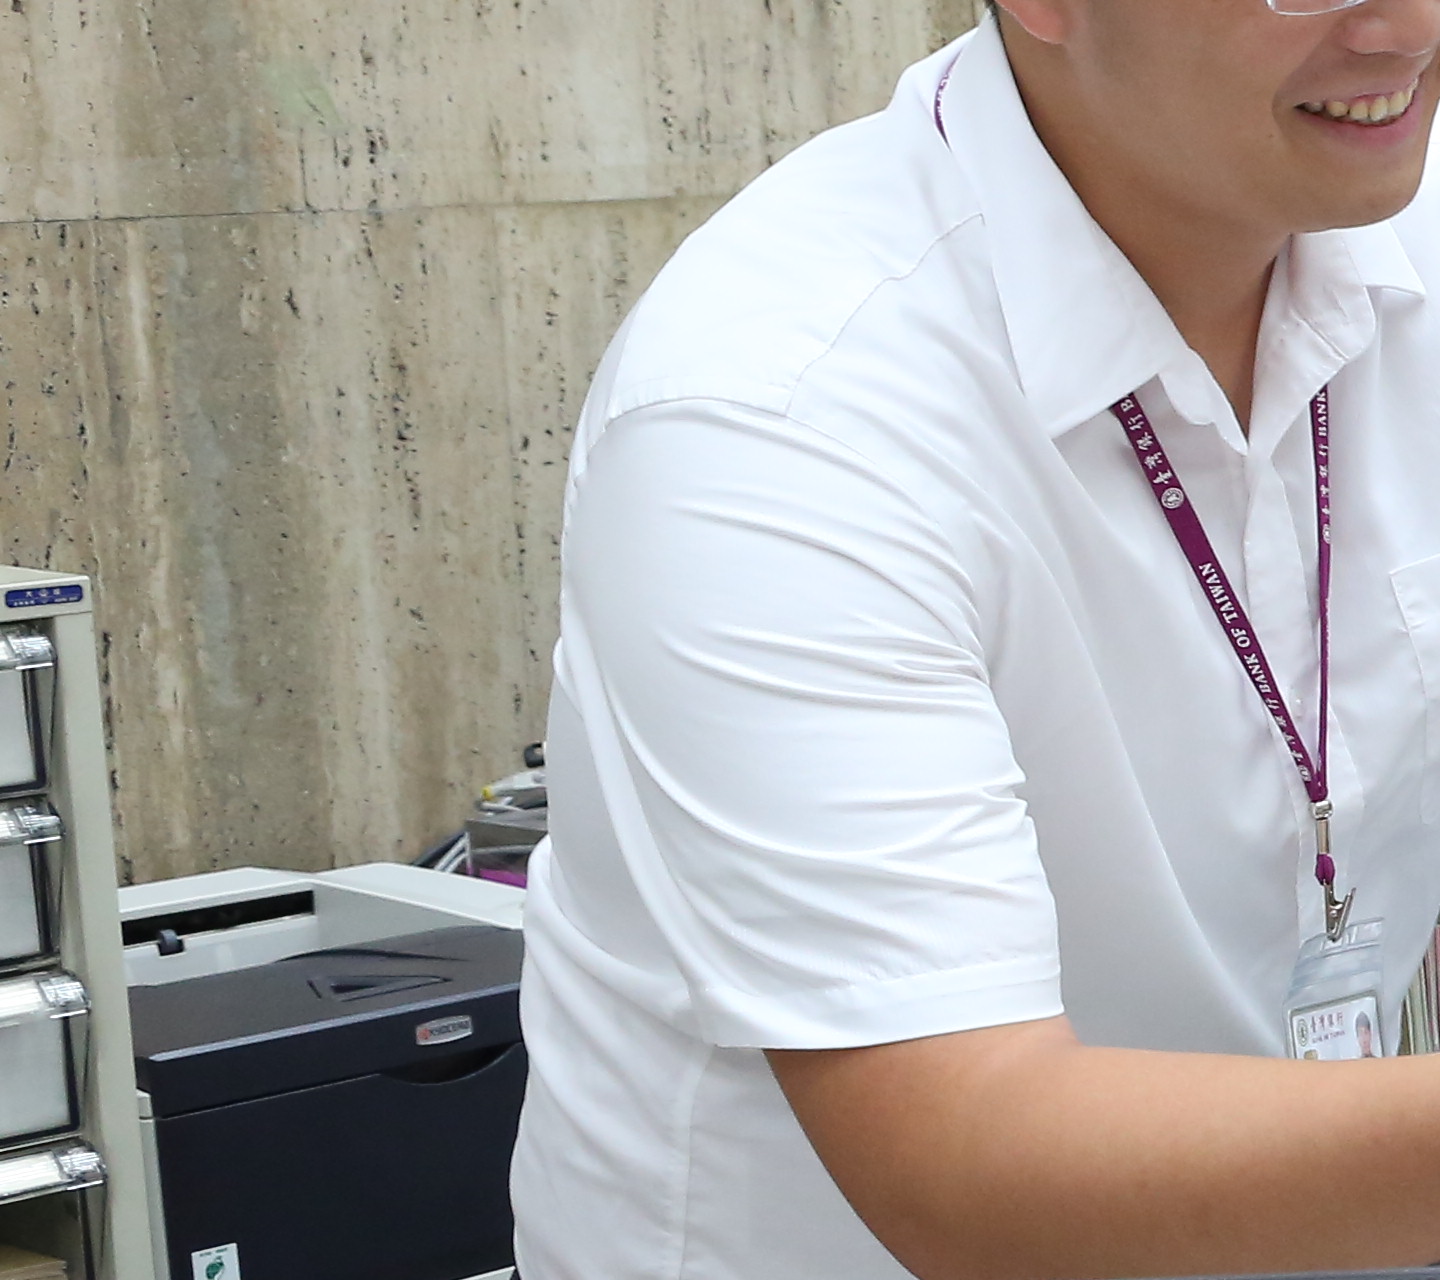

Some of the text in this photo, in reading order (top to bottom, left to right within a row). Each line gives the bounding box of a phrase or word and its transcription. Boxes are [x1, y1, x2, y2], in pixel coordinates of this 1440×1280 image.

[1198, 562, 1238, 624] TAIWAN
[1230, 627, 1251, 649] OF
[1243, 652, 1272, 694] BANK
